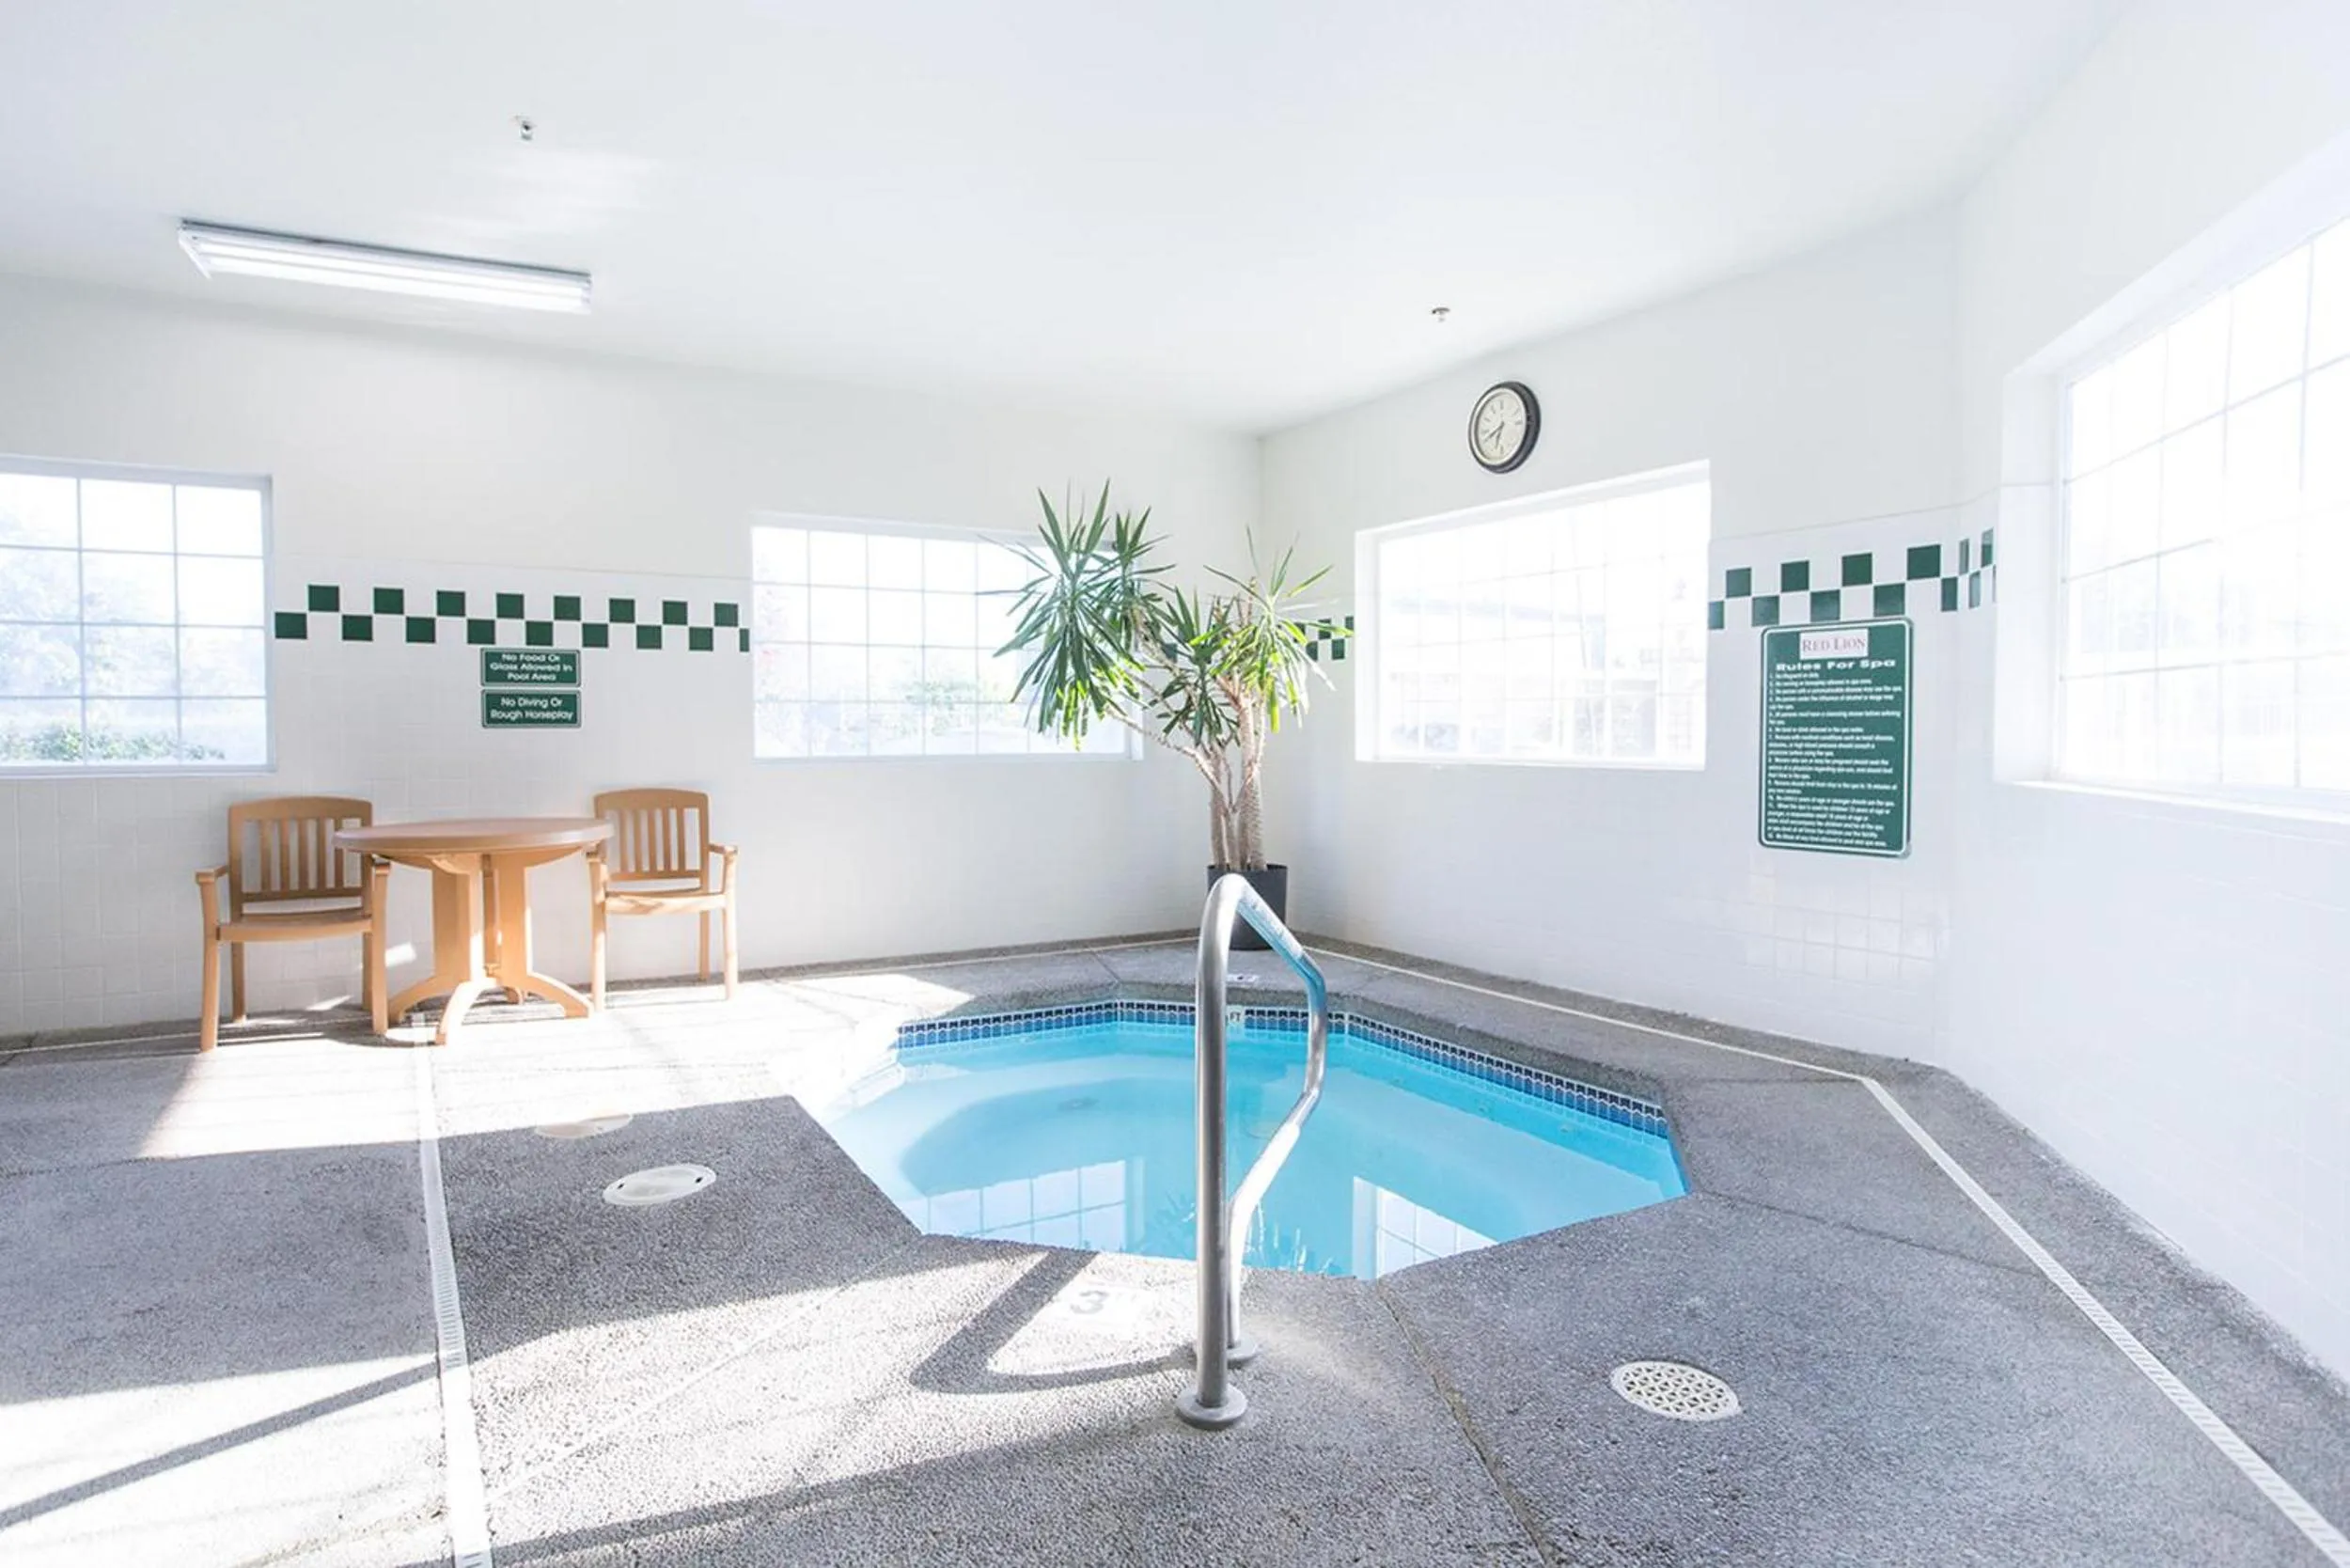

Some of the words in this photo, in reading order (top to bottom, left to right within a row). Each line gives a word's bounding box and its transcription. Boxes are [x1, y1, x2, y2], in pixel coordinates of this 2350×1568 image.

[1802, 639, 1830, 651] RED
[1834, 636, 1866, 651] LION
[501, 653, 518, 662] No
[519, 653, 546, 662] Food
[547, 653, 560, 663] Or
[1776, 661, 1822, 670] Rules
[1826, 660, 1856, 669] For
[1859, 658, 1896, 669] Spa
[490, 662, 518, 671] Glass
[520, 663, 561, 672] Allowed
[562, 663, 573, 672] In
[508, 672, 529, 681] Pool
[531, 672, 556, 682] Area
[500, 697, 516, 707] No
[517, 697, 549, 709] Diving
[550, 697, 563, 707] Or
[490, 709, 524, 721] Rough
[525, 710, 574, 721] Horseplay
[1070, 1290, 1110, 1315] 3
